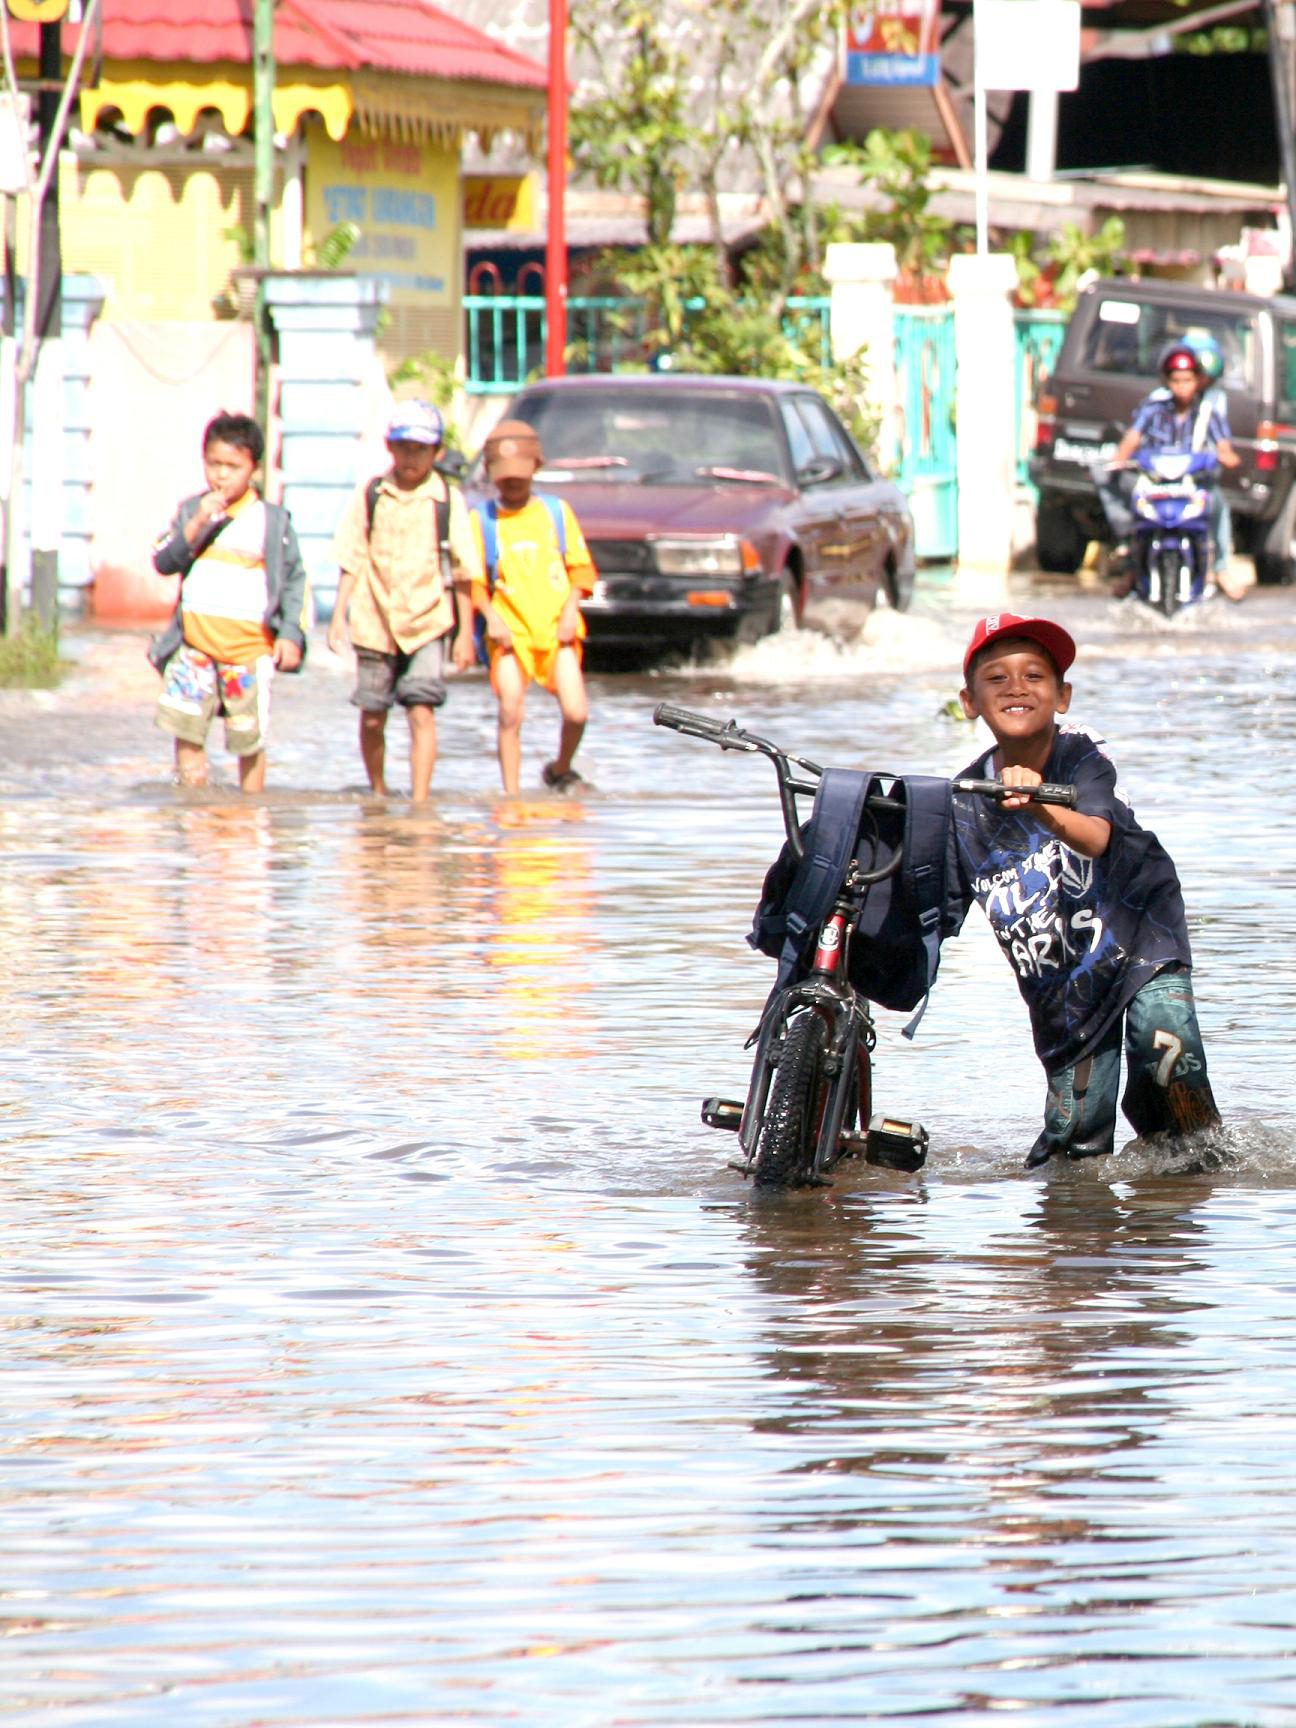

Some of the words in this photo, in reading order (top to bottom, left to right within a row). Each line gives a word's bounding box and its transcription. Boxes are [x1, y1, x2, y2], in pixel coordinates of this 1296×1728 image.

[971, 867, 1019, 893] VOLCOM
[1010, 906, 1056, 937] THE
[1153, 1029, 1182, 1088] 7
